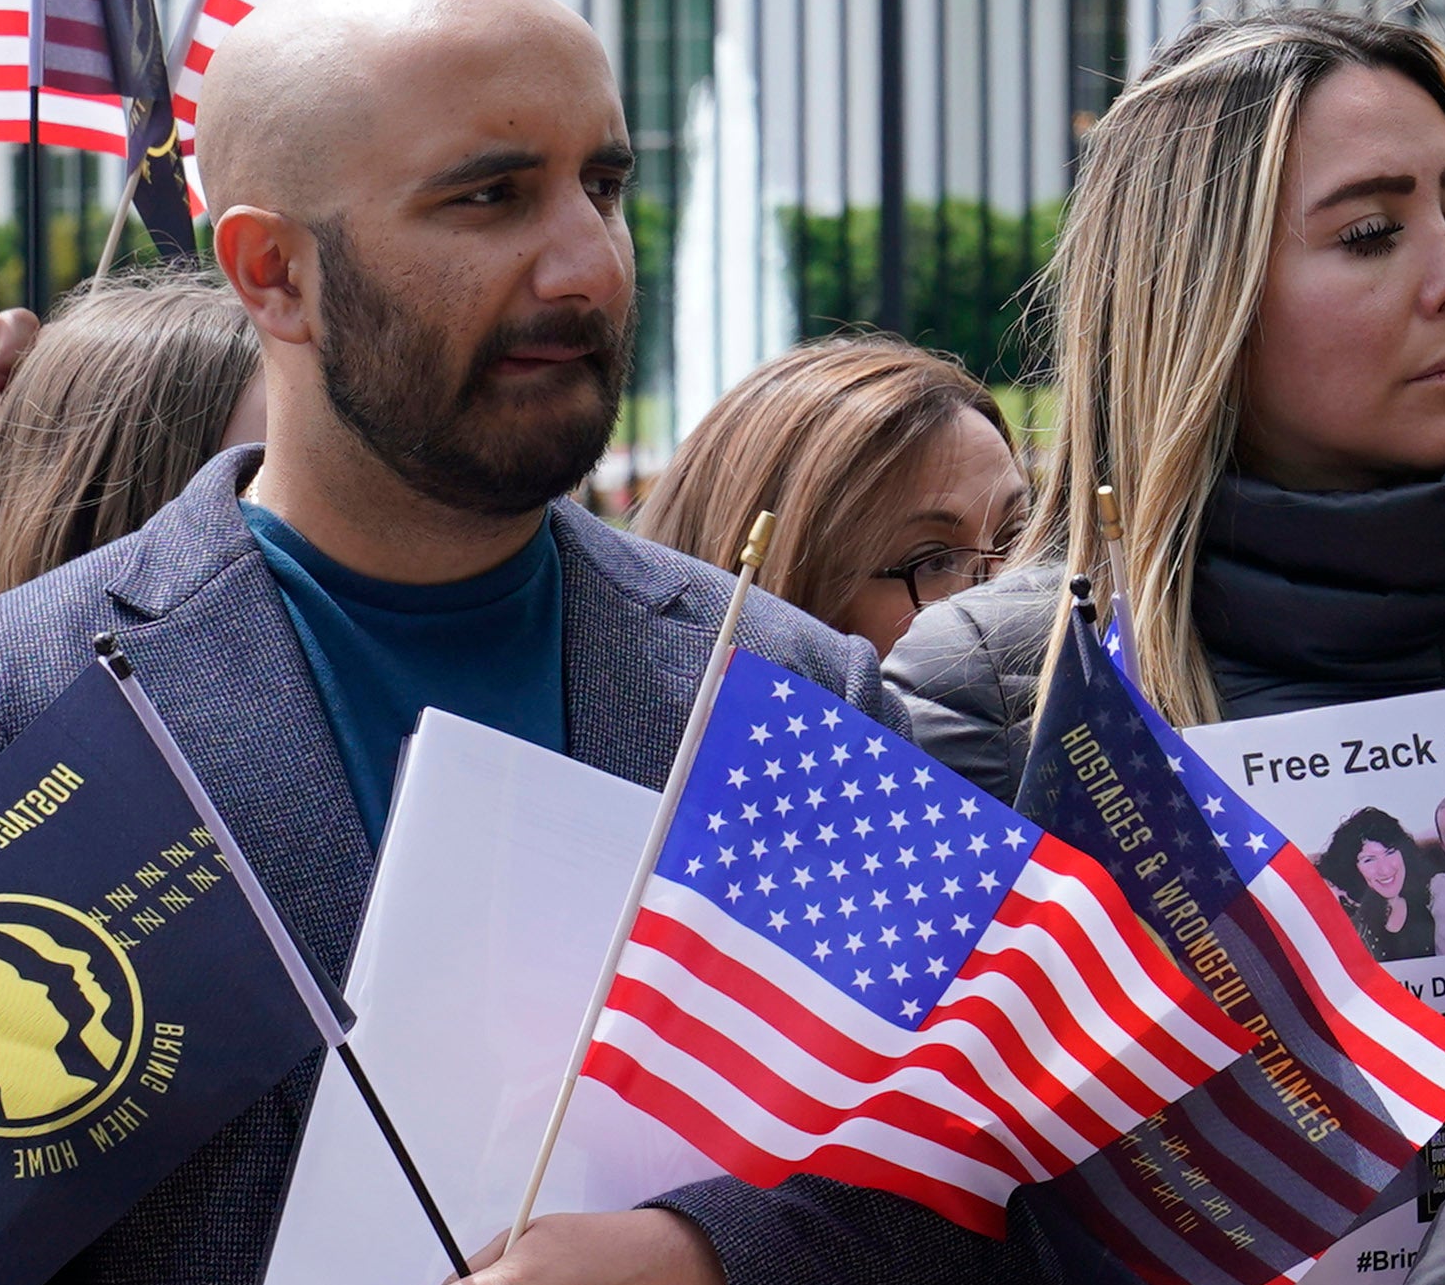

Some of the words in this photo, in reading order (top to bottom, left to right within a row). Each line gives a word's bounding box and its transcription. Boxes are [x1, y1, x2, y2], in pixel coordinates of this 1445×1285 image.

[1243, 752, 1330, 786] Free
[1341, 734, 1437, 774] Zack
[1061, 723, 1153, 853] HOSTAGES
[1135, 851, 1166, 879] &
[1152, 877, 1252, 1016] WRONGFUL
